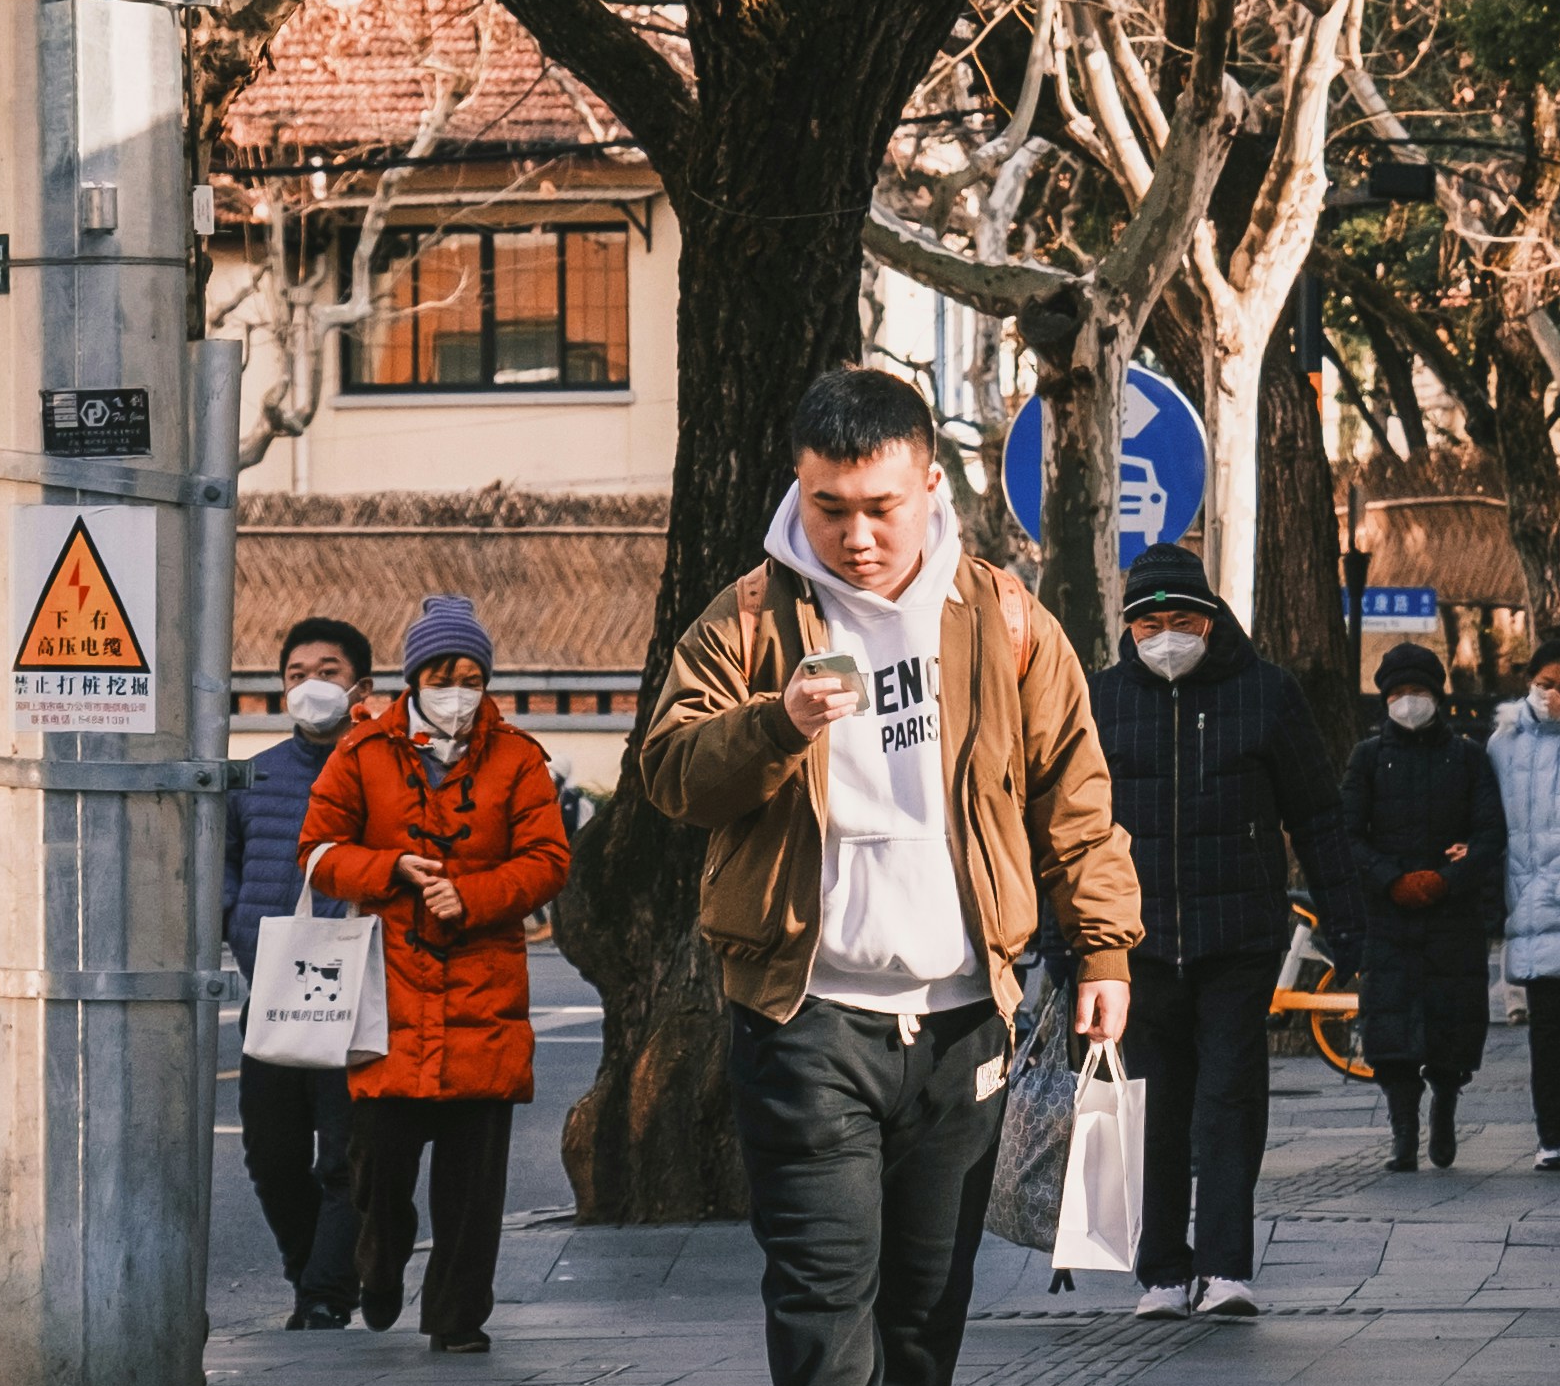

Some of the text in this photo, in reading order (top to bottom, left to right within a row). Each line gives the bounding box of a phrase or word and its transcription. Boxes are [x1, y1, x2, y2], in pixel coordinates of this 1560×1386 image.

[50, 610, 108, 630] 下有
[37, 636, 122, 657] 高压电缆
[14, 675, 149, 696] 禁止打桩挖掘
[881, 714, 938, 753] PARIS
